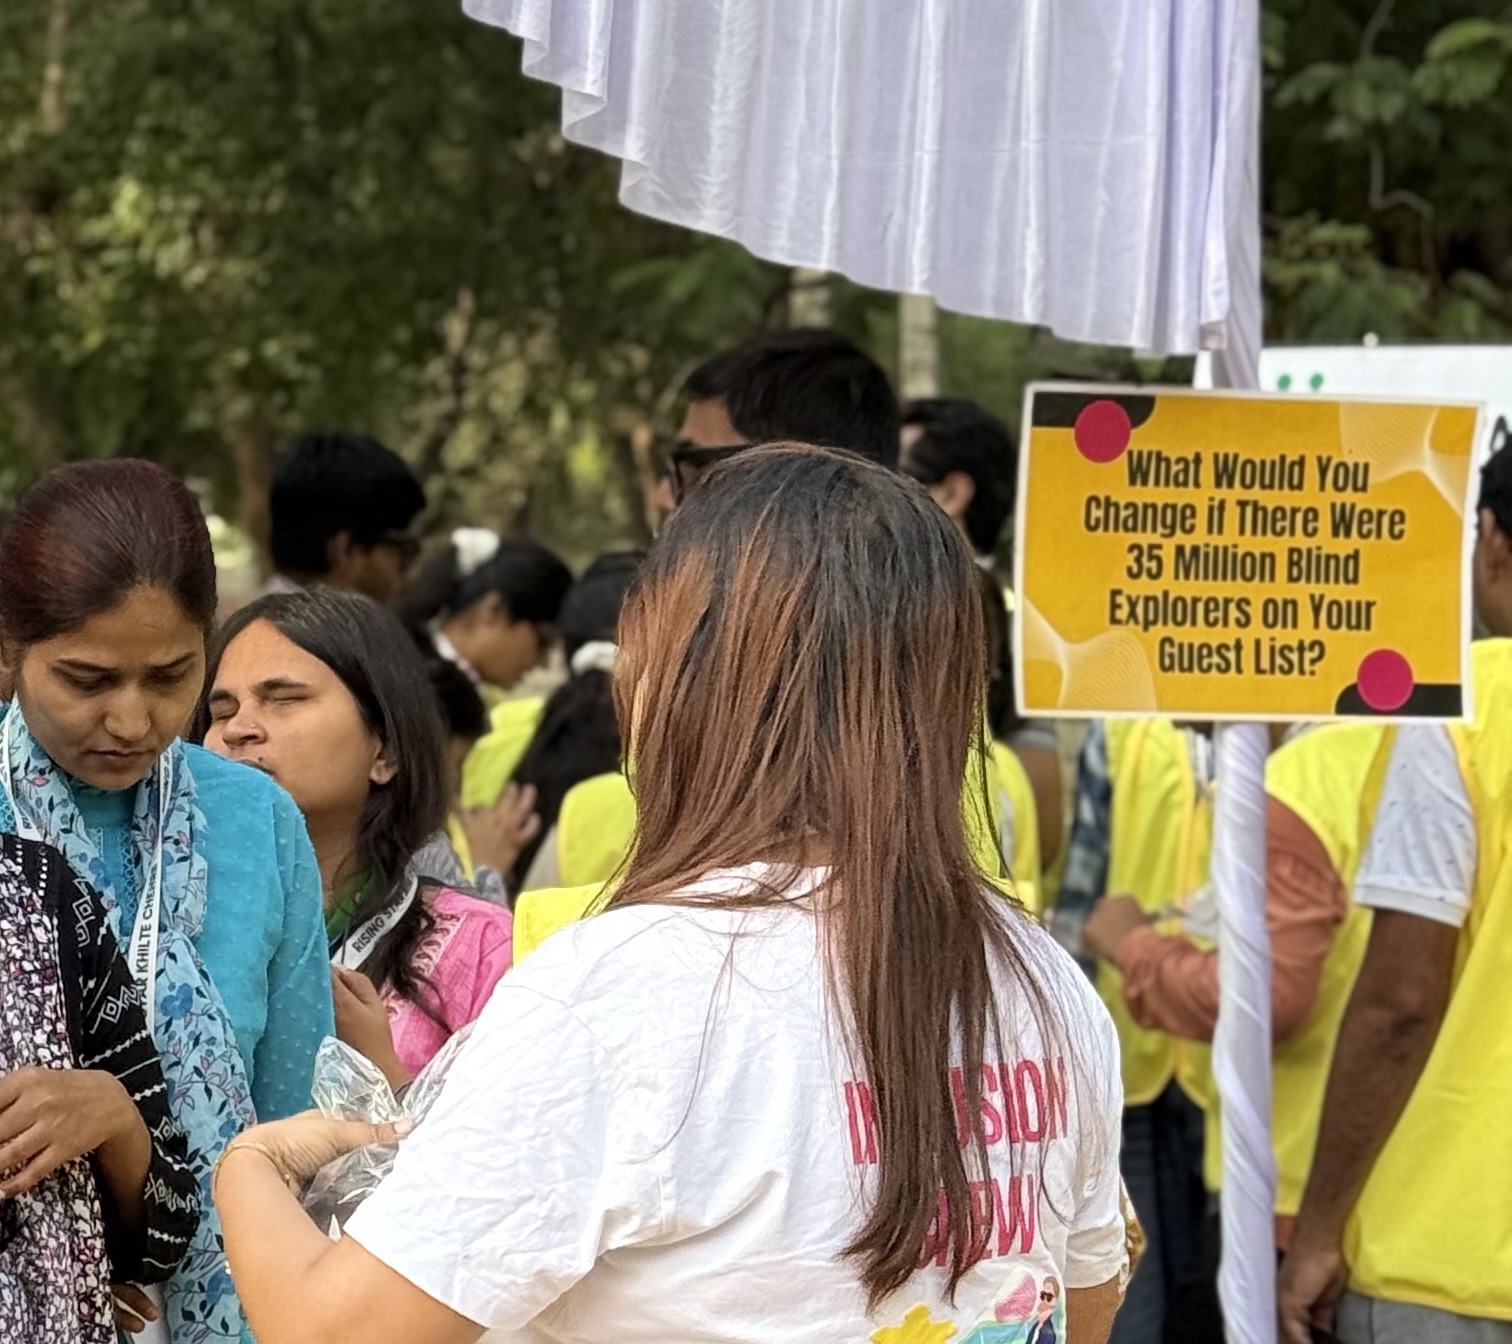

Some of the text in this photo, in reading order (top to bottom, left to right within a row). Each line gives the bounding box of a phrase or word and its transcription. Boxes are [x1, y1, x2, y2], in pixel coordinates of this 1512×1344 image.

[1126, 449, 1371, 494] What Would You
[1084, 494, 1406, 540] Change if There Were
[1126, 543, 1361, 585] 35 Million Blind
[1109, 588, 1377, 633] Explorers on Your
[1158, 636, 1327, 677] Guest List?
[135, 921, 153, 974] KHILTE
[351, 916, 385, 953] RISING
